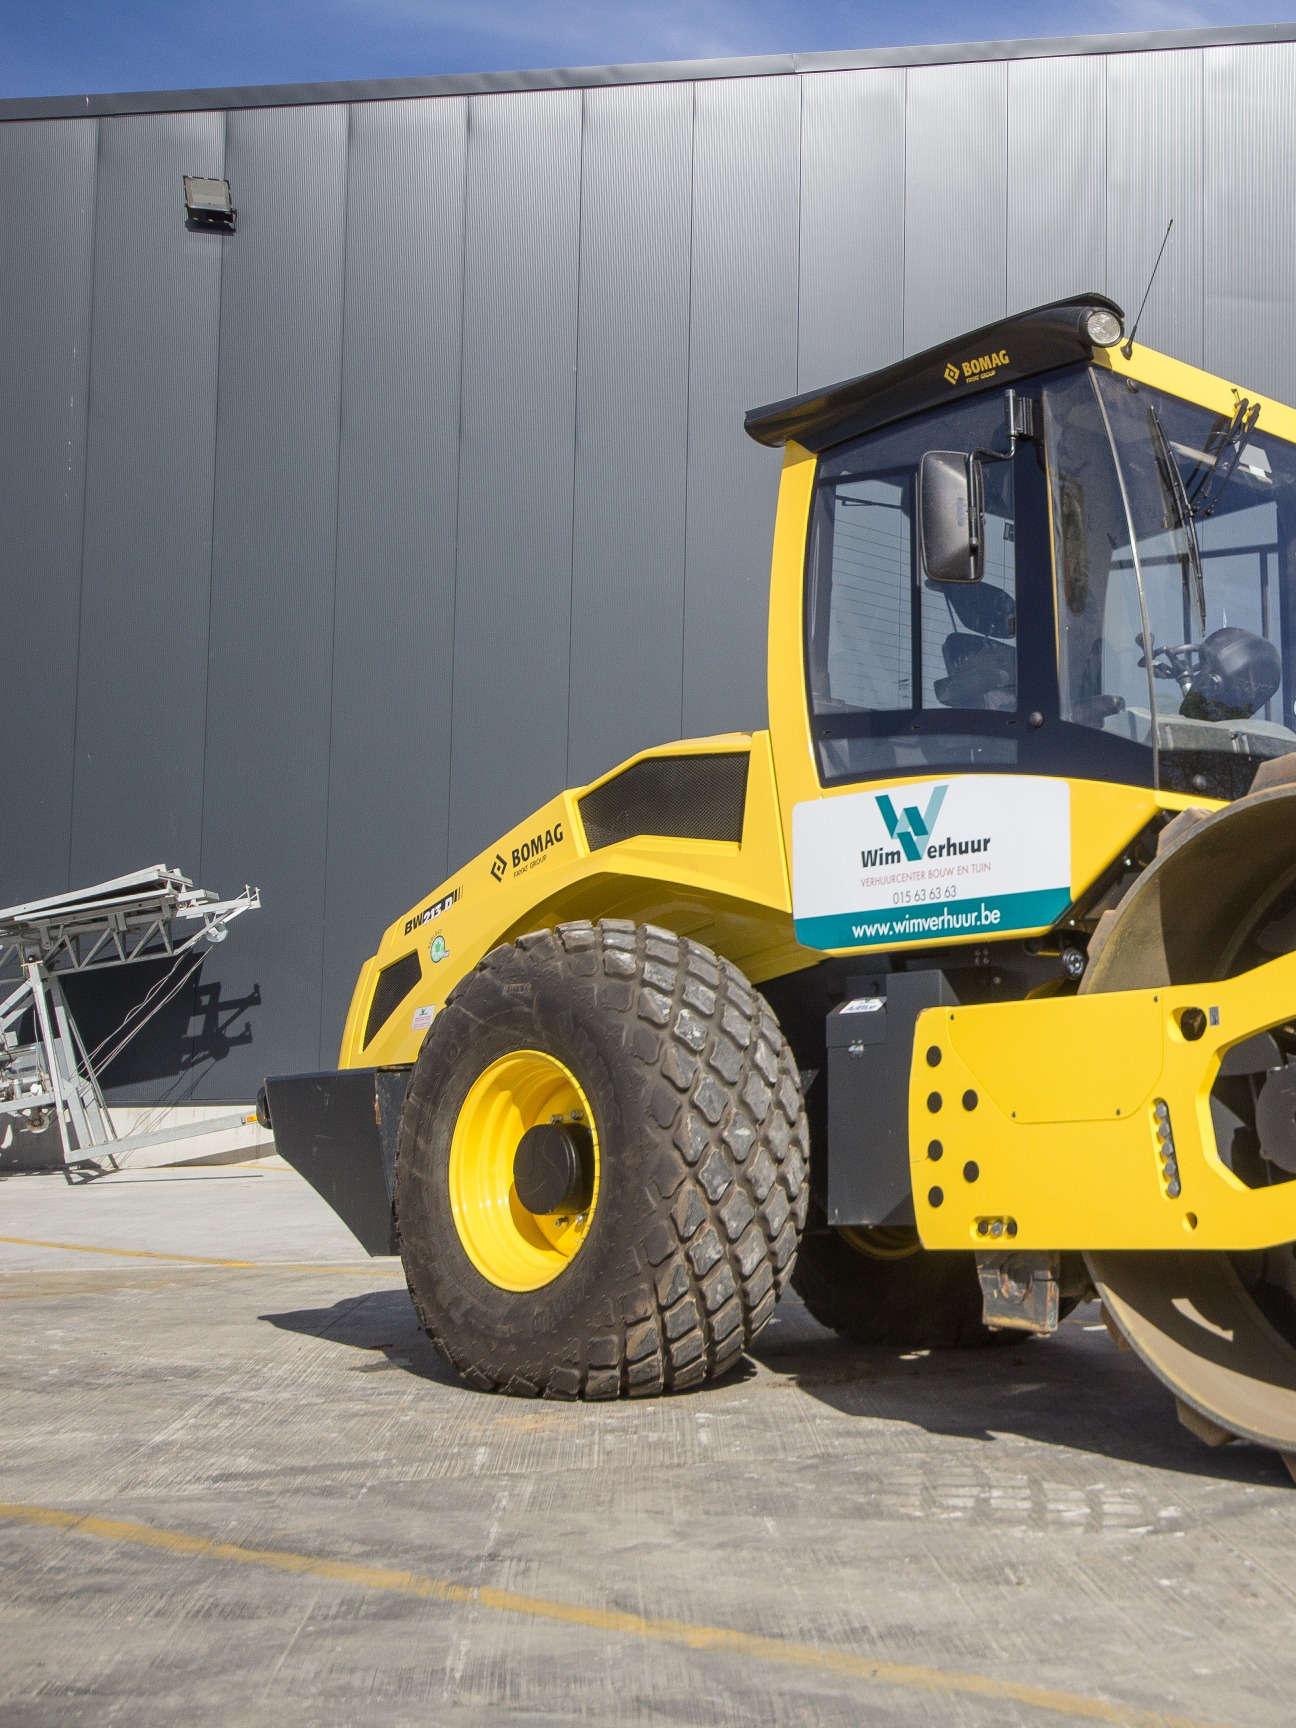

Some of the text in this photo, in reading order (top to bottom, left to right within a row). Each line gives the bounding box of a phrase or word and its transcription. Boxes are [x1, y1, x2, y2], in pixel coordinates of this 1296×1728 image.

[961, 349, 1010, 377] BOMAG
[511, 822, 564, 869] BOMAG
[861, 847, 901, 868] Wim
[513, 854, 547, 879] FAYAT GROUP
[860, 862, 992, 888] VERHUURCENTER BOUW EN TUIN
[444, 896, 453, 912] D
[892, 884, 957, 905] 015 63 63 63
[851, 902, 1001, 939] www.wimverhuur.be
